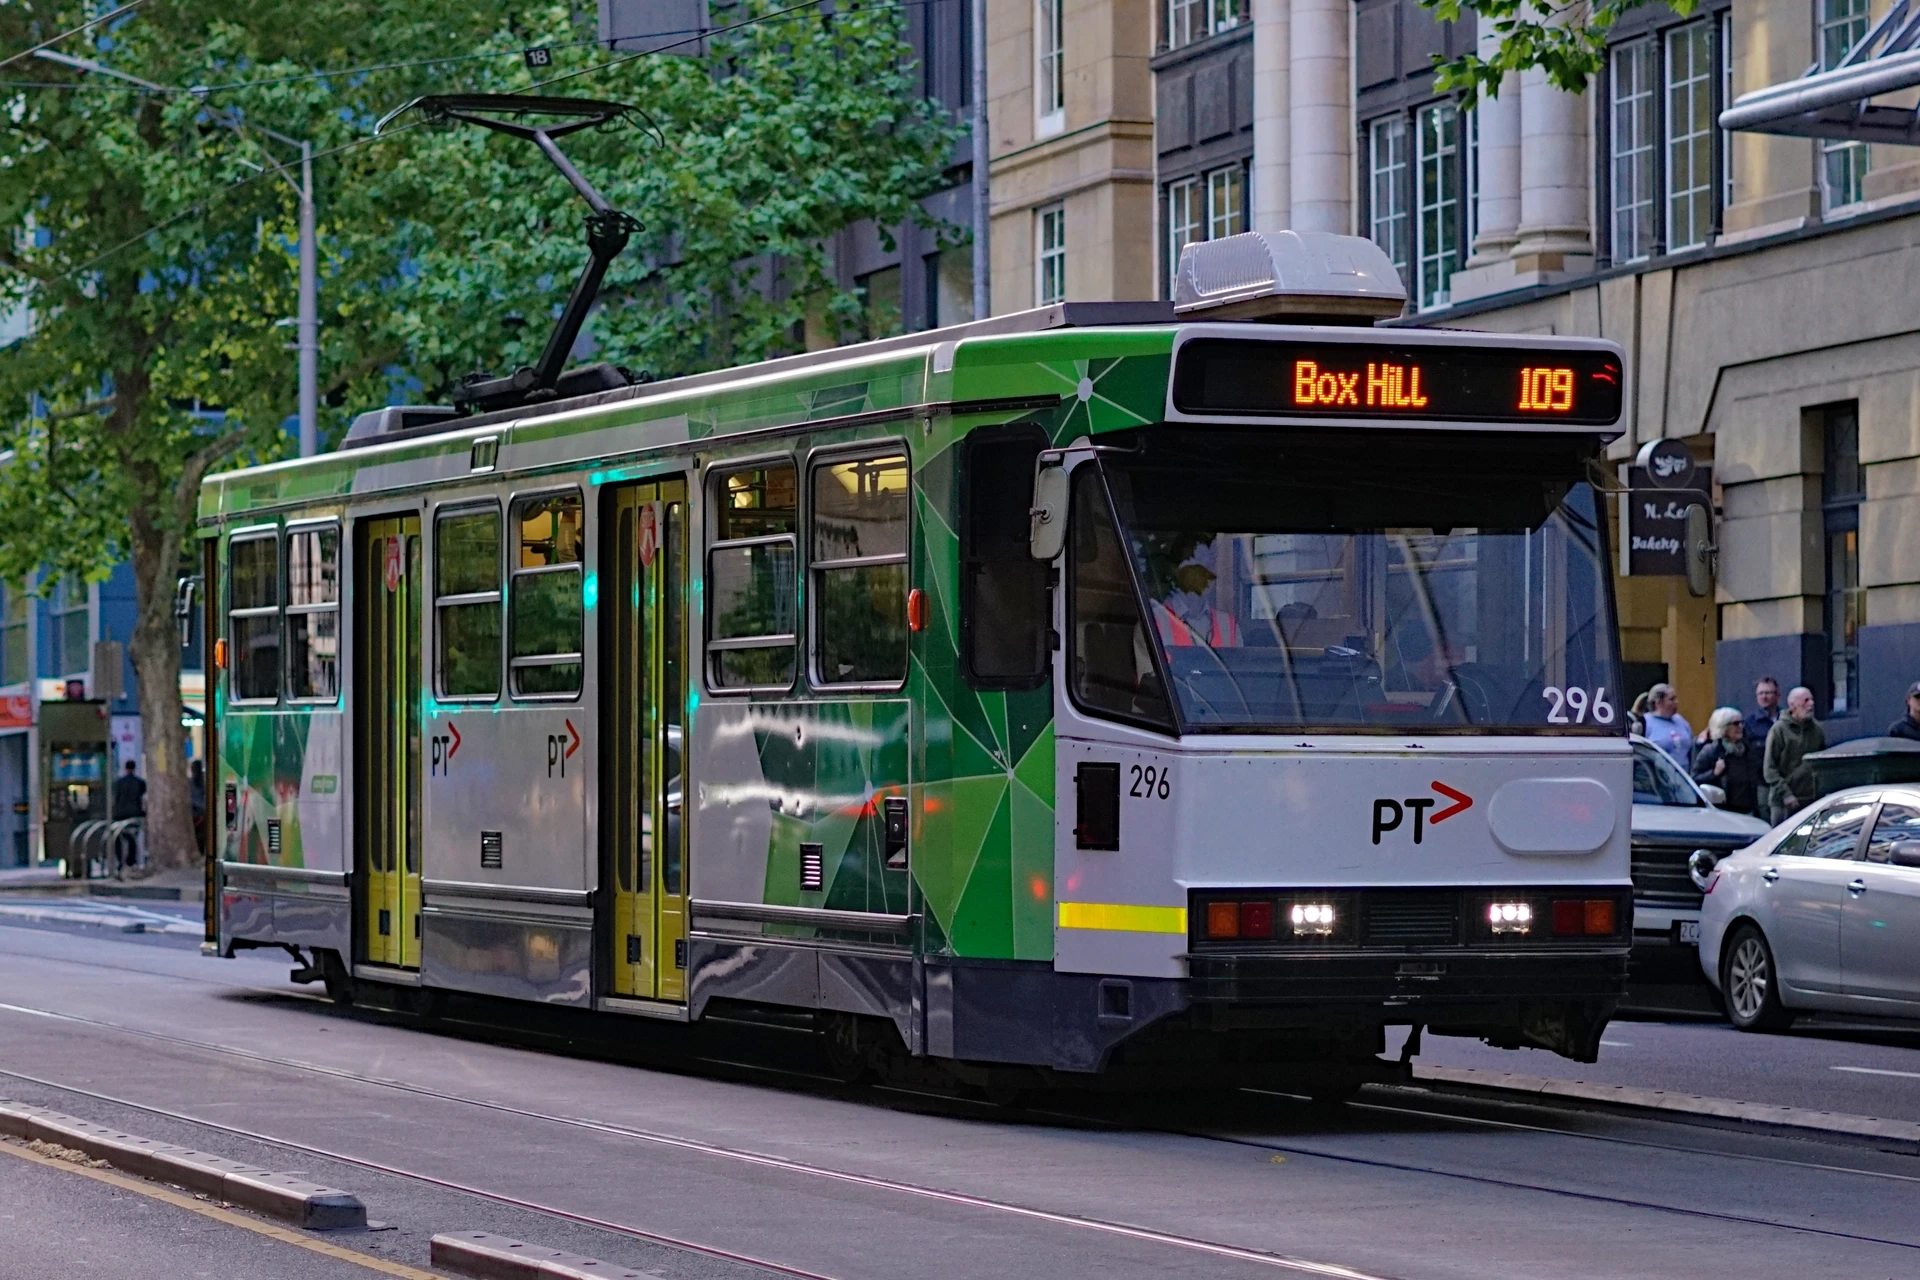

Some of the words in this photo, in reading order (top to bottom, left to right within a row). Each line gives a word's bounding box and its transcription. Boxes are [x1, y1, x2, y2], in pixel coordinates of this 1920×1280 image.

[529, 50, 548, 65] 18
[1296, 361, 1358, 404] Box
[1519, 367, 1573, 410] 109
[1632, 536, 1679, 555] Bakery
[1542, 686, 1614, 724] 296
[1129, 764, 1170, 800] 296
